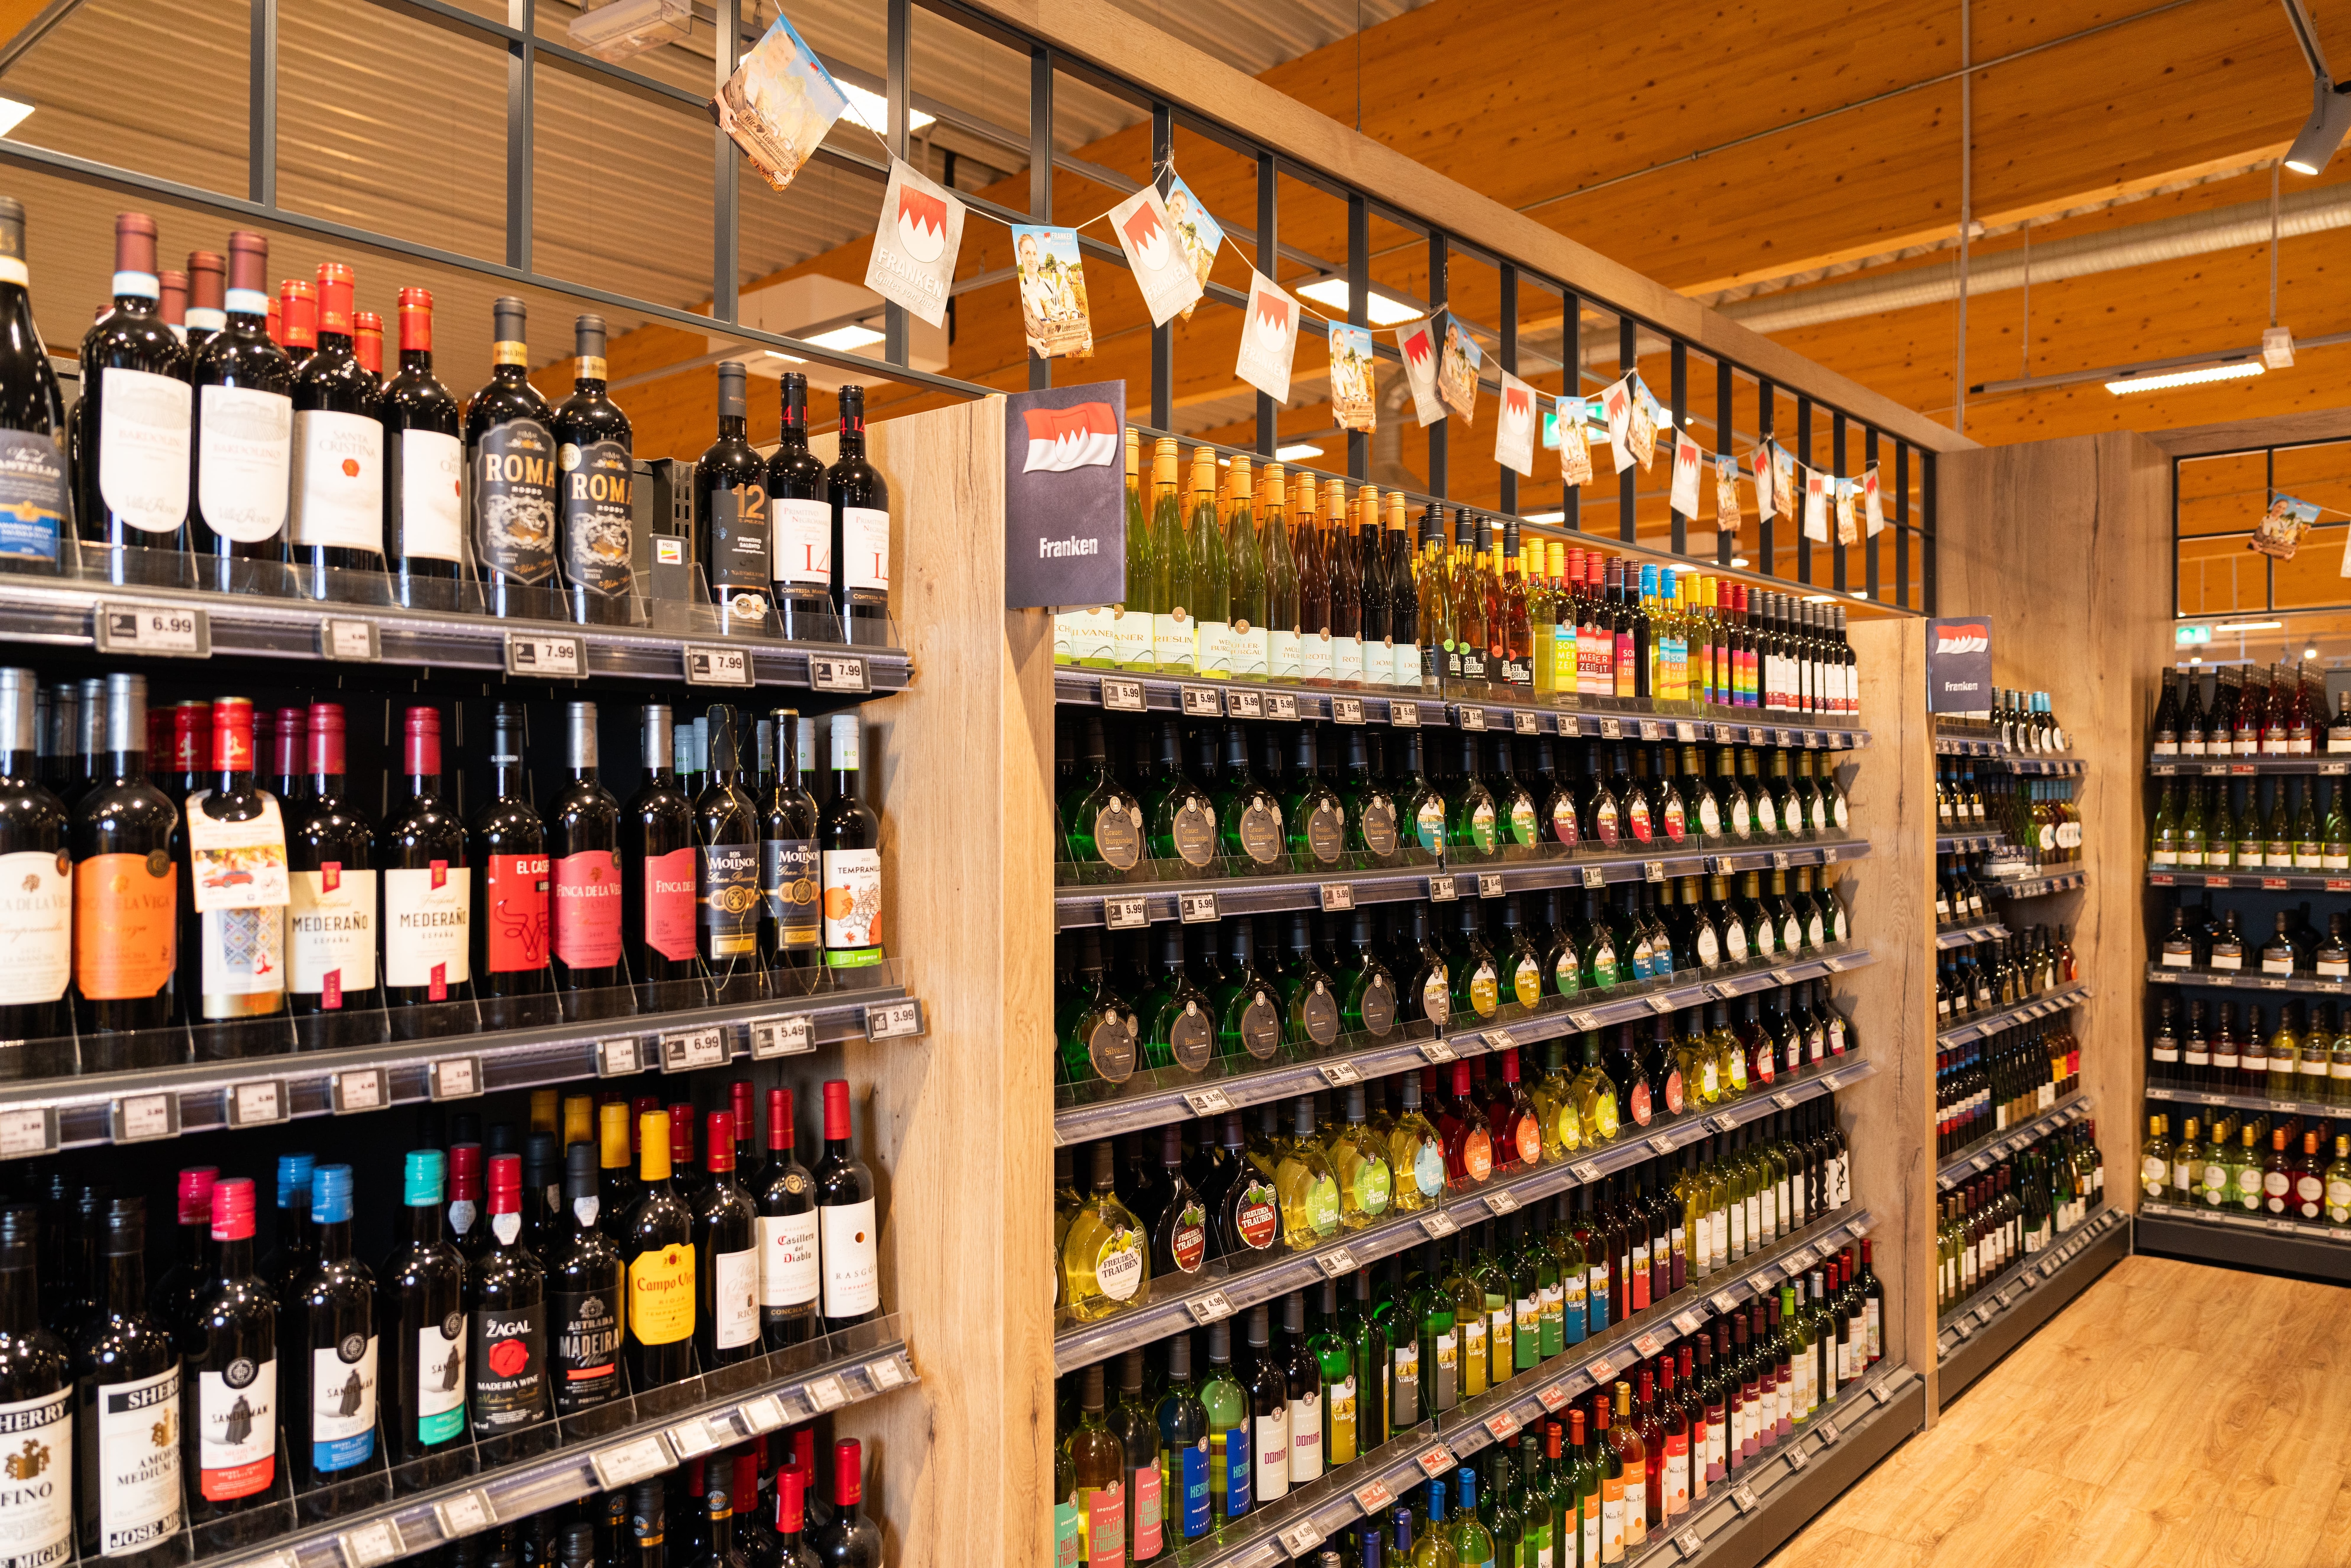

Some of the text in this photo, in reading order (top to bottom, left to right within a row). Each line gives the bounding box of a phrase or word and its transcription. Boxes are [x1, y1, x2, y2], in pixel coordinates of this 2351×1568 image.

[744, 112, 796, 169] Wir Lebensmittel.
[1201, 214, 1219, 236] FRANKEN
[876, 246, 944, 299] FRANKEN
[1146, 262, 1189, 302] FRANKEN
[875, 269, 938, 313] Gutes von hier.
[1062, 323, 1088, 333] Lebensmittel.
[1354, 331, 1369, 339] FRANKEN
[1243, 343, 1287, 378] FRANKEN
[333, 430, 368, 444] SANTA
[213, 443, 281, 460] BARDOLINO
[319, 439, 376, 457] CRISTINA
[485, 454, 555, 488] ROMA
[512, 486, 542, 496] ROSSO
[732, 483, 765, 519] 12
[597, 505, 624, 513] ROSSO
[784, 507, 819, 517] PRIMITIVO
[856, 516, 884, 525] PRIMITIVO
[1040, 536, 1097, 558] Franken
[153, 616, 192, 632] 6.99
[1557, 641, 1575, 650] SOM
[546, 645, 574, 659] 7.99
[718, 656, 742, 668] 7.99
[1579, 662, 1596, 671] ZEIT
[838, 665, 860, 677] 7.99
[1123, 686, 1139, 698] 5.99
[1945, 681, 1978, 692] Franken
[1200, 693, 1215, 703] 5.99
[1245, 697, 1258, 706] 5.99
[1281, 700, 1294, 709] 5.99
[1105, 836, 1133, 845] Burgunder
[779, 850, 819, 865] MOLINOS
[517, 860, 529, 874] EL
[710, 857, 755, 871] MOLINOS
[556, 884, 608, 897] FINCA DE LA
[656, 880, 681, 893] FINCA
[1337, 890, 1348, 898] 5.99
[1126, 905, 1142, 914] 5.99
[1199, 899, 1213, 908] 5.99
[292, 911, 368, 932] MEDERAÑO
[400, 907, 466, 929] MEDERAÑO
[893, 1010, 914, 1021] 3.99
[1311, 1013, 1330, 1022] Riesling
[781, 1026, 804, 1038] 5.49
[694, 1036, 718, 1049] 6.99
[1206, 1094, 1223, 1103] 5.99
[1474, 1158, 1488, 1166] JUNGEN
[1425, 1173, 1439, 1182] JUNGEN
[1366, 1190, 1384, 1199] JUNGEN
[1499, 1196, 1510, 1204] 5.49
[1243, 1206, 1269, 1220] FREUDEN
[1318, 1211, 1335, 1220] JUNGEN
[1242, 1212, 1273, 1228] TRAUBEN
[778, 1233, 814, 1245] Casillero
[1178, 1228, 1200, 1242] FREUDEN
[1177, 1233, 1202, 1252] TRAUBEN
[784, 1251, 811, 1262] Diablo
[1104, 1252, 1134, 1269] FREUDEN
[1334, 1253, 1348, 1262] 5.49
[1103, 1257, 1138, 1278] TRAUBEN
[637, 1277, 676, 1293] Campo
[1209, 1298, 1224, 1308] 4.99
[486, 1320, 532, 1338] ZAGAL
[559, 1328, 619, 1357] MADEIRA
[477, 1375, 539, 1391] MADEIRA WINE
[1500, 1419, 1511, 1427] 4.44
[1296, 1432, 1319, 1446] DOMINA
[1434, 1450, 1446, 1461] 4.44
[118, 1462, 170, 1487] MEDIUM
[1, 1482, 52, 1505] FINO
[1373, 1486, 1386, 1497] 4.44
[1097, 1504, 1115, 1513] SPOTLIGHT
[111, 1525, 159, 1547] JOSE
[1298, 1526, 1313, 1538] 4.99
